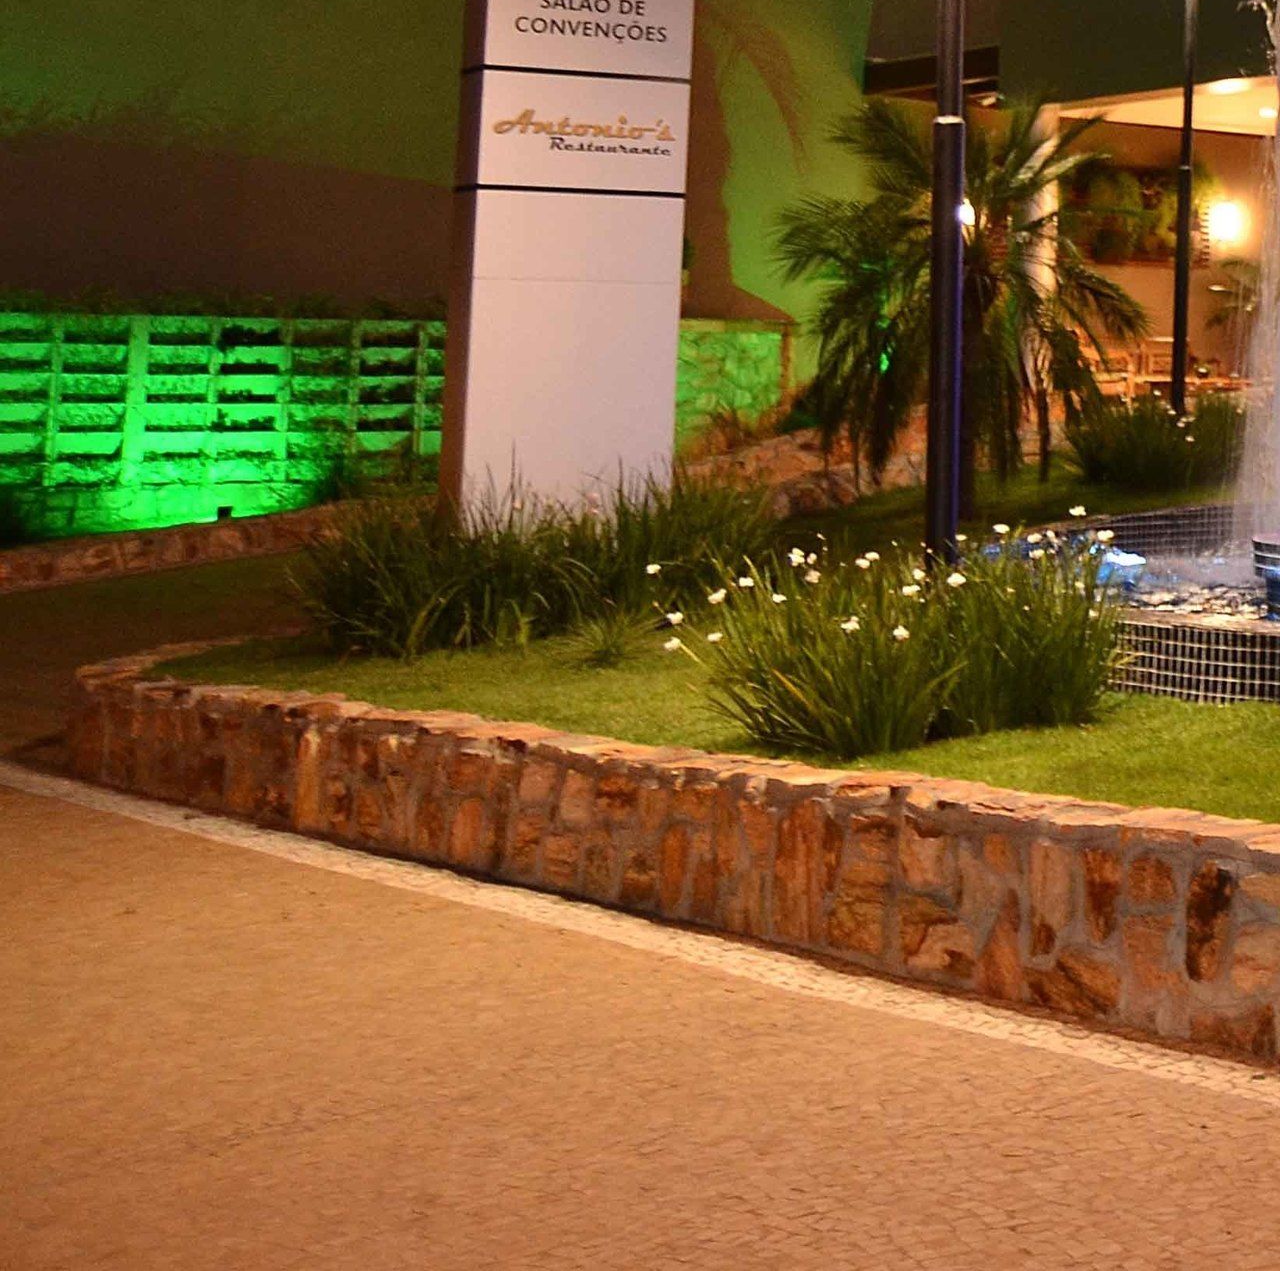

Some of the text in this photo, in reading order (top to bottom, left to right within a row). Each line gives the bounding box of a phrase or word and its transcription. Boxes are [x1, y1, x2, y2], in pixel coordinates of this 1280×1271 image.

[514, 16, 667, 43] CONVENÇÕES
[492, 108, 676, 142] Antonio's
[549, 136, 672, 157] Restaurante
